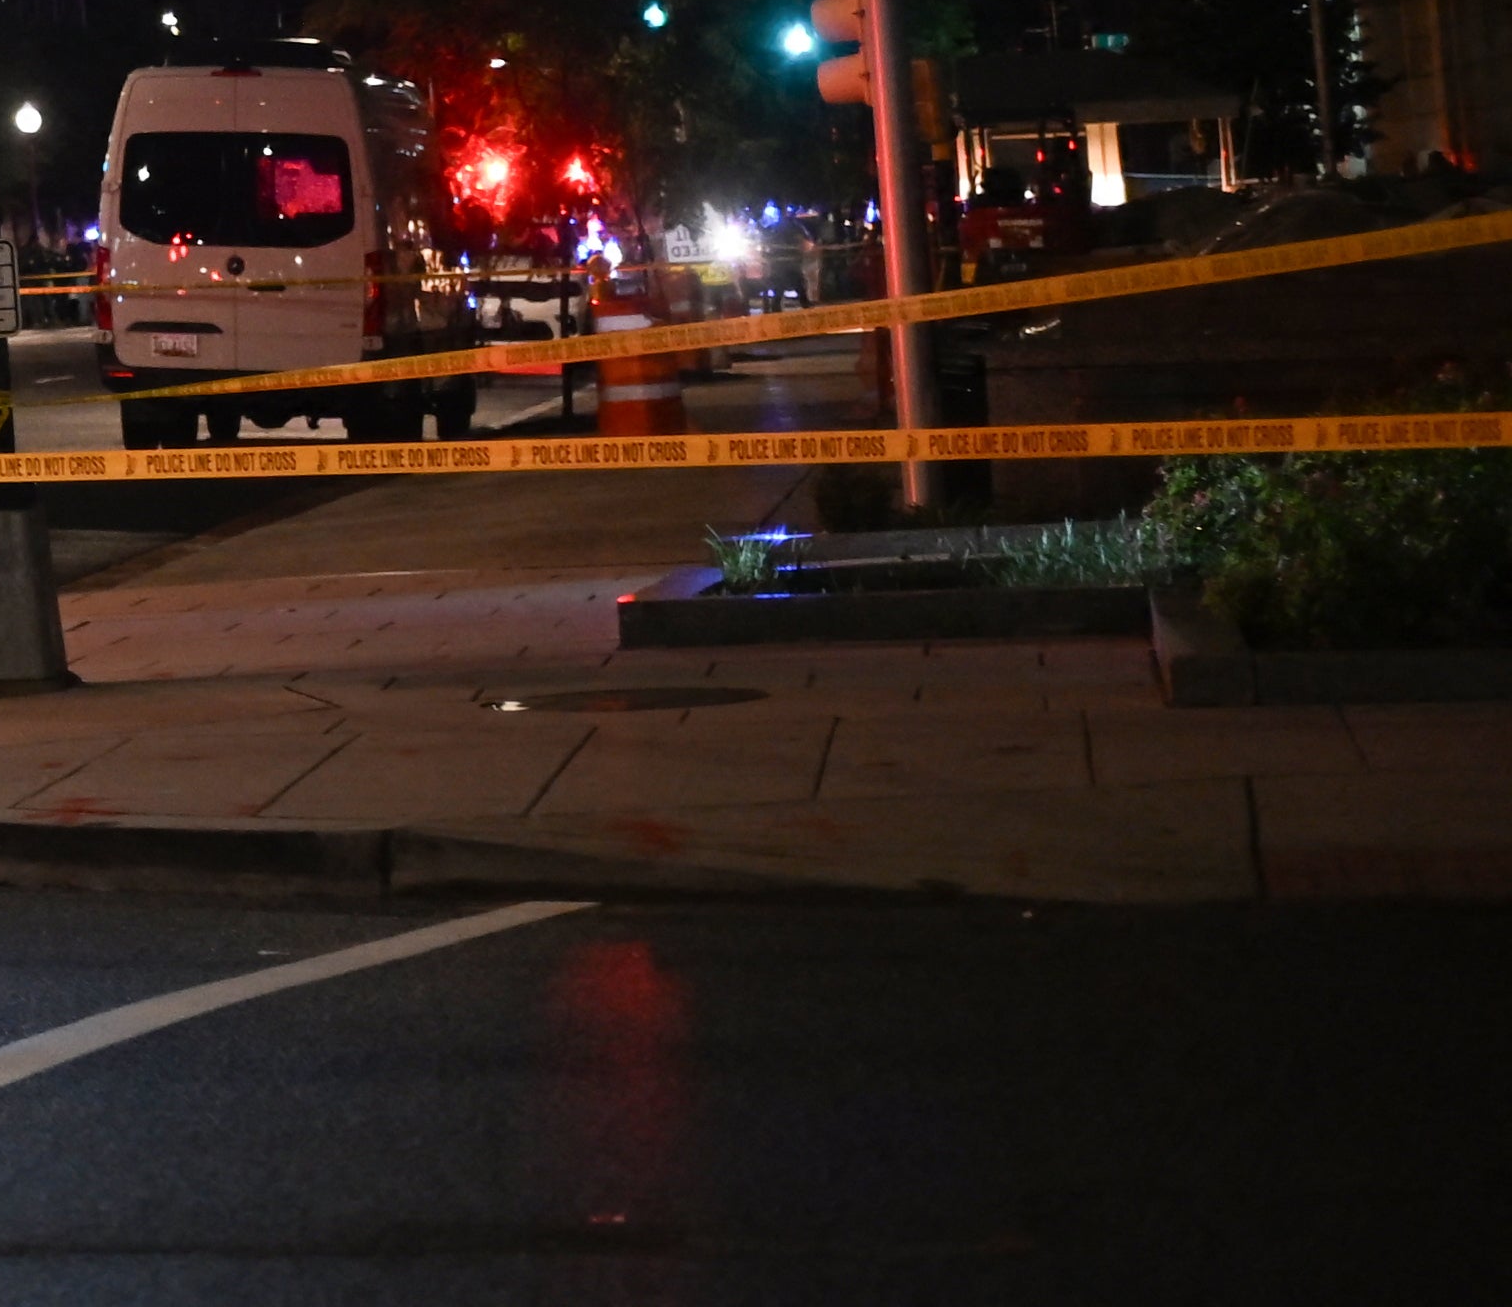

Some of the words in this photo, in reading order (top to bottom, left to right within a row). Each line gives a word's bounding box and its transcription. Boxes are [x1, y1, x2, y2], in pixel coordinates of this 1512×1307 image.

[729, 439, 770, 460] POLICE
[772, 438, 798, 459] LINE
[800, 437, 817, 458] DO
[820, 437, 842, 457] NOT
[846, 435, 885, 457] CROSS
[929, 433, 970, 455] POLICE
[973, 433, 999, 454] LINE
[1002, 432, 1019, 453] DO
[1022, 431, 1044, 453] NOT
[1048, 430, 1088, 452] CROSS
[1132, 428, 1174, 450] POLICE
[1176, 427, 1203, 449] LINE
[1206, 426, 1223, 448] DO
[1226, 426, 1249, 448] NOT
[1253, 424, 1293, 447] CROSS
[146, 454, 185, 474] POLICE
[188, 453, 212, 473] LINE
[215, 453, 231, 472] DO
[234, 452, 255, 472] NOT
[258, 451, 296, 471] CROSS
[338, 450, 378, 469] POLICE
[380, 449, 405, 468] LINE
[407, 449, 424, 468] DO
[427, 448, 448, 468] NOT
[452, 447, 490, 467] CROSS
[532, 444, 572, 464] POLICE
[574, 443, 600, 463] LINE
[603, 443, 619, 463] DO
[623, 442, 644, 462] NOT
[648, 441, 687, 462] CROSS
[25, 457, 41, 477] DO
[44, 457, 65, 476] NOT
[68, 456, 105, 476] CROSS
